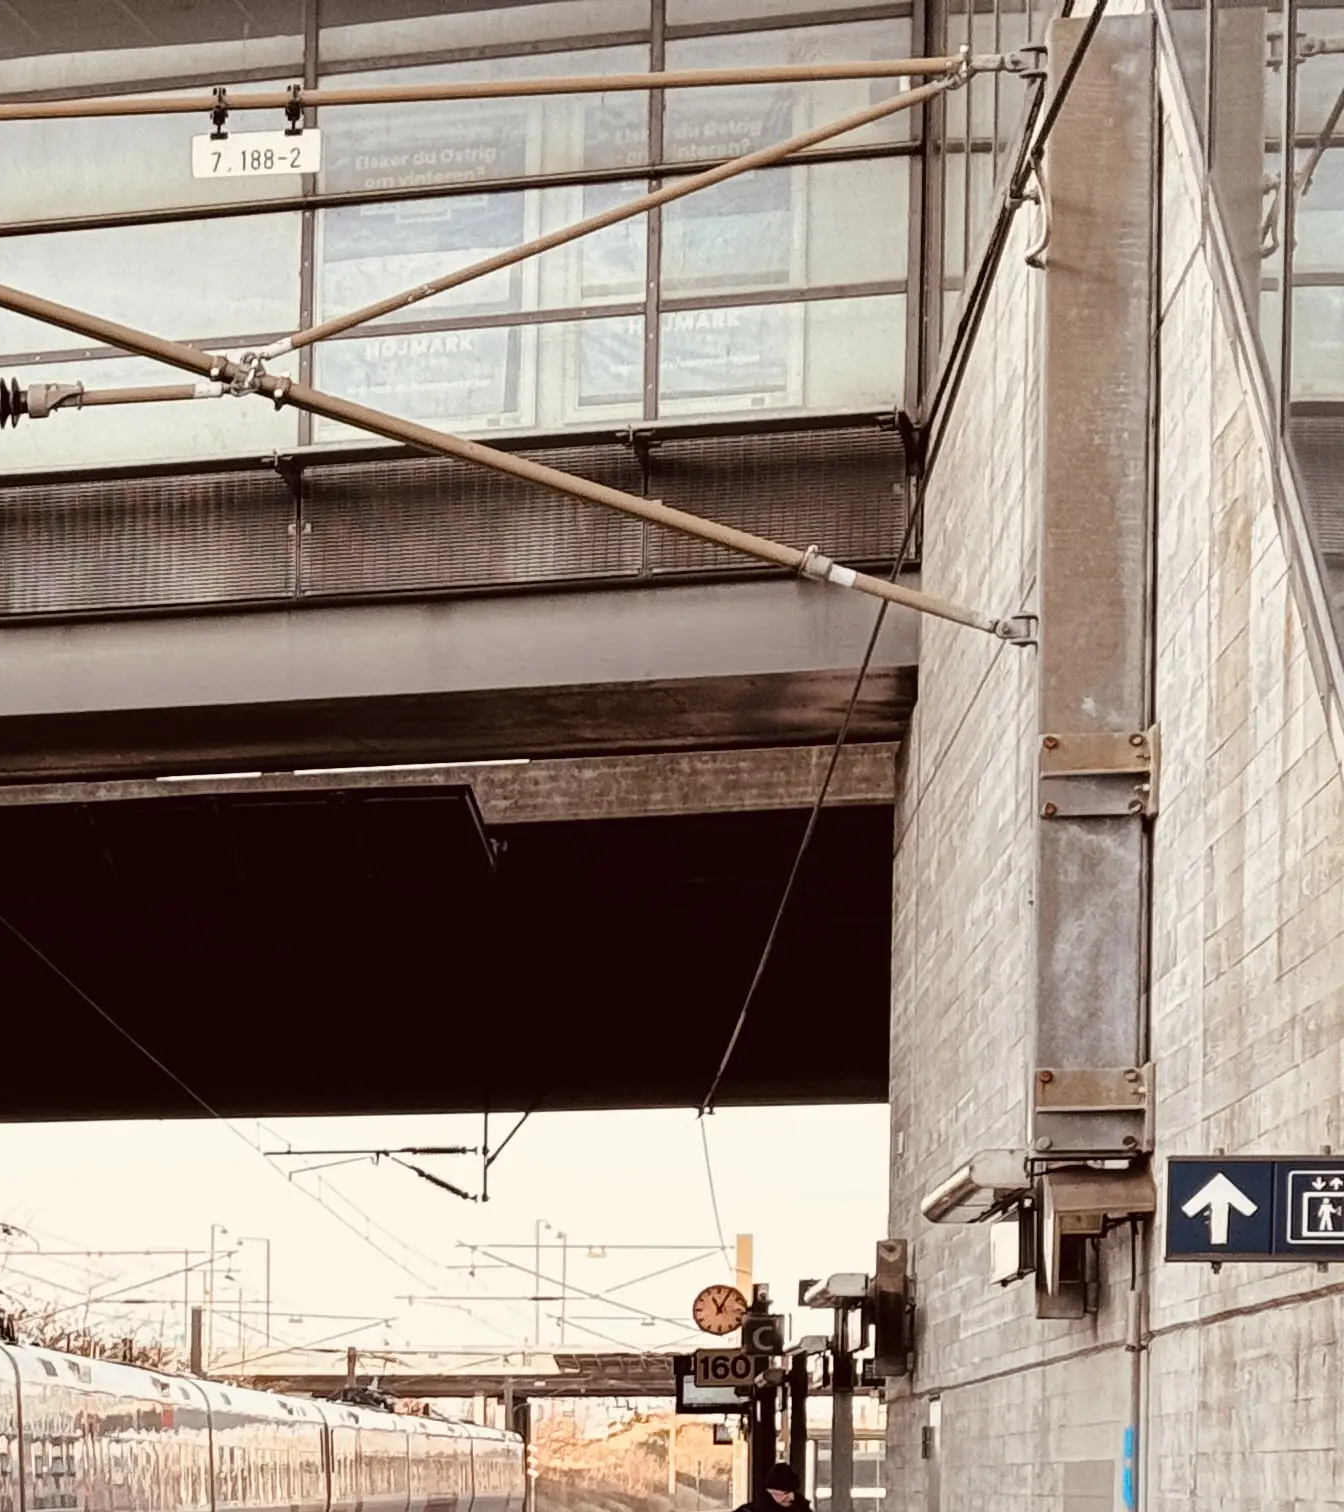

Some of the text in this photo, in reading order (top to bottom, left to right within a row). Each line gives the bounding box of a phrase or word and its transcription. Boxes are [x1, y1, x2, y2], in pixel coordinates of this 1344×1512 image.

[211, 147, 301, 173] 7.188-2
[413, 149, 437, 165] du
[628, 309, 741, 334] HJMARK
[753, 1326, 774, 1351] C
[699, 1355, 752, 1380] 160
